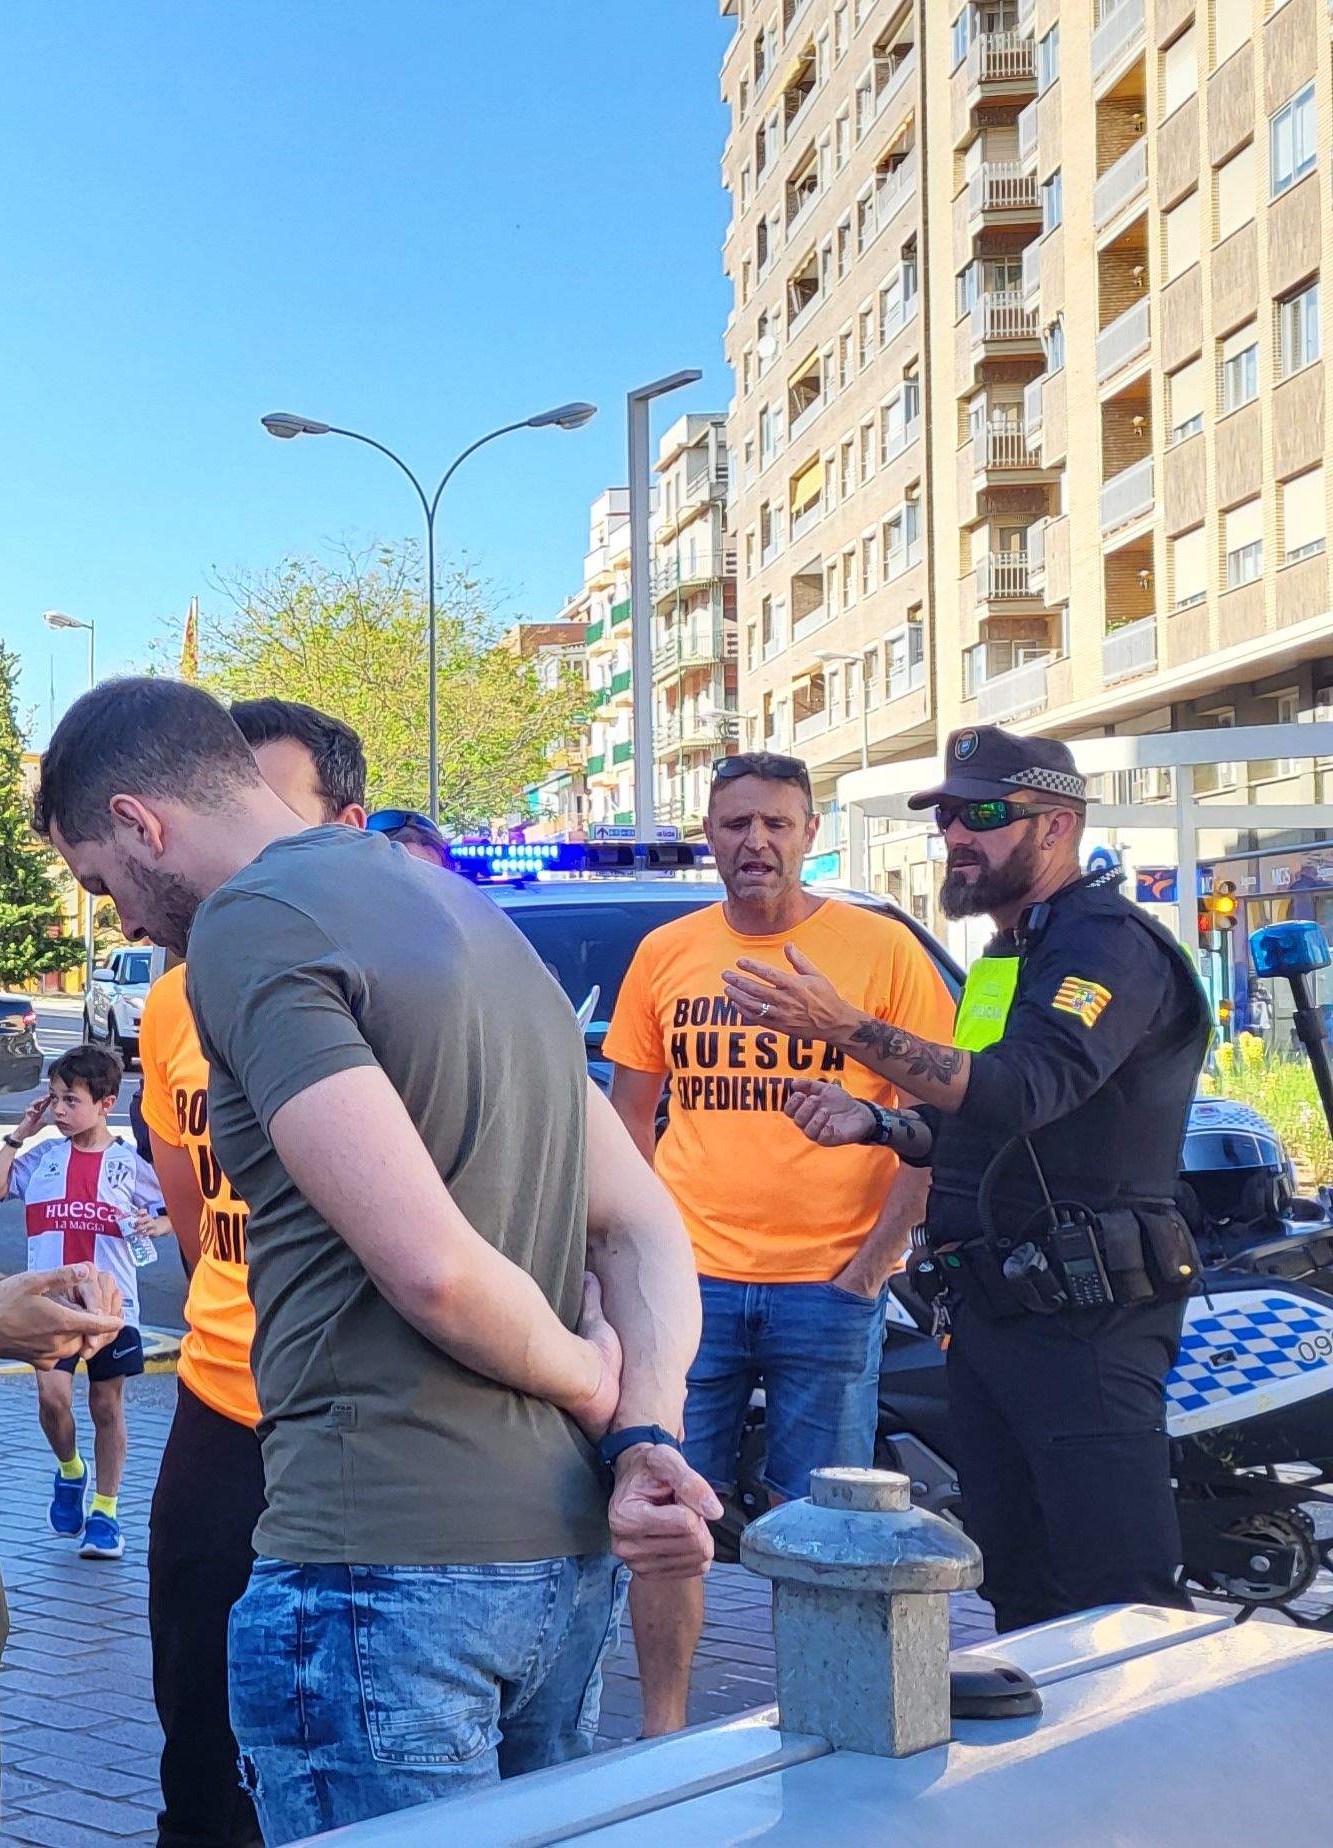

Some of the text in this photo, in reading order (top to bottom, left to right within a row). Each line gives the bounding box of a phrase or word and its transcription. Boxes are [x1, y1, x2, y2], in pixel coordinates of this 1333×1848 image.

[674, 995, 758, 1028] BOM
[671, 1031, 846, 1072] HUESCA
[677, 1075, 843, 1113] EXPEDIENTA
[1297, 1330, 1333, 1362] 09
